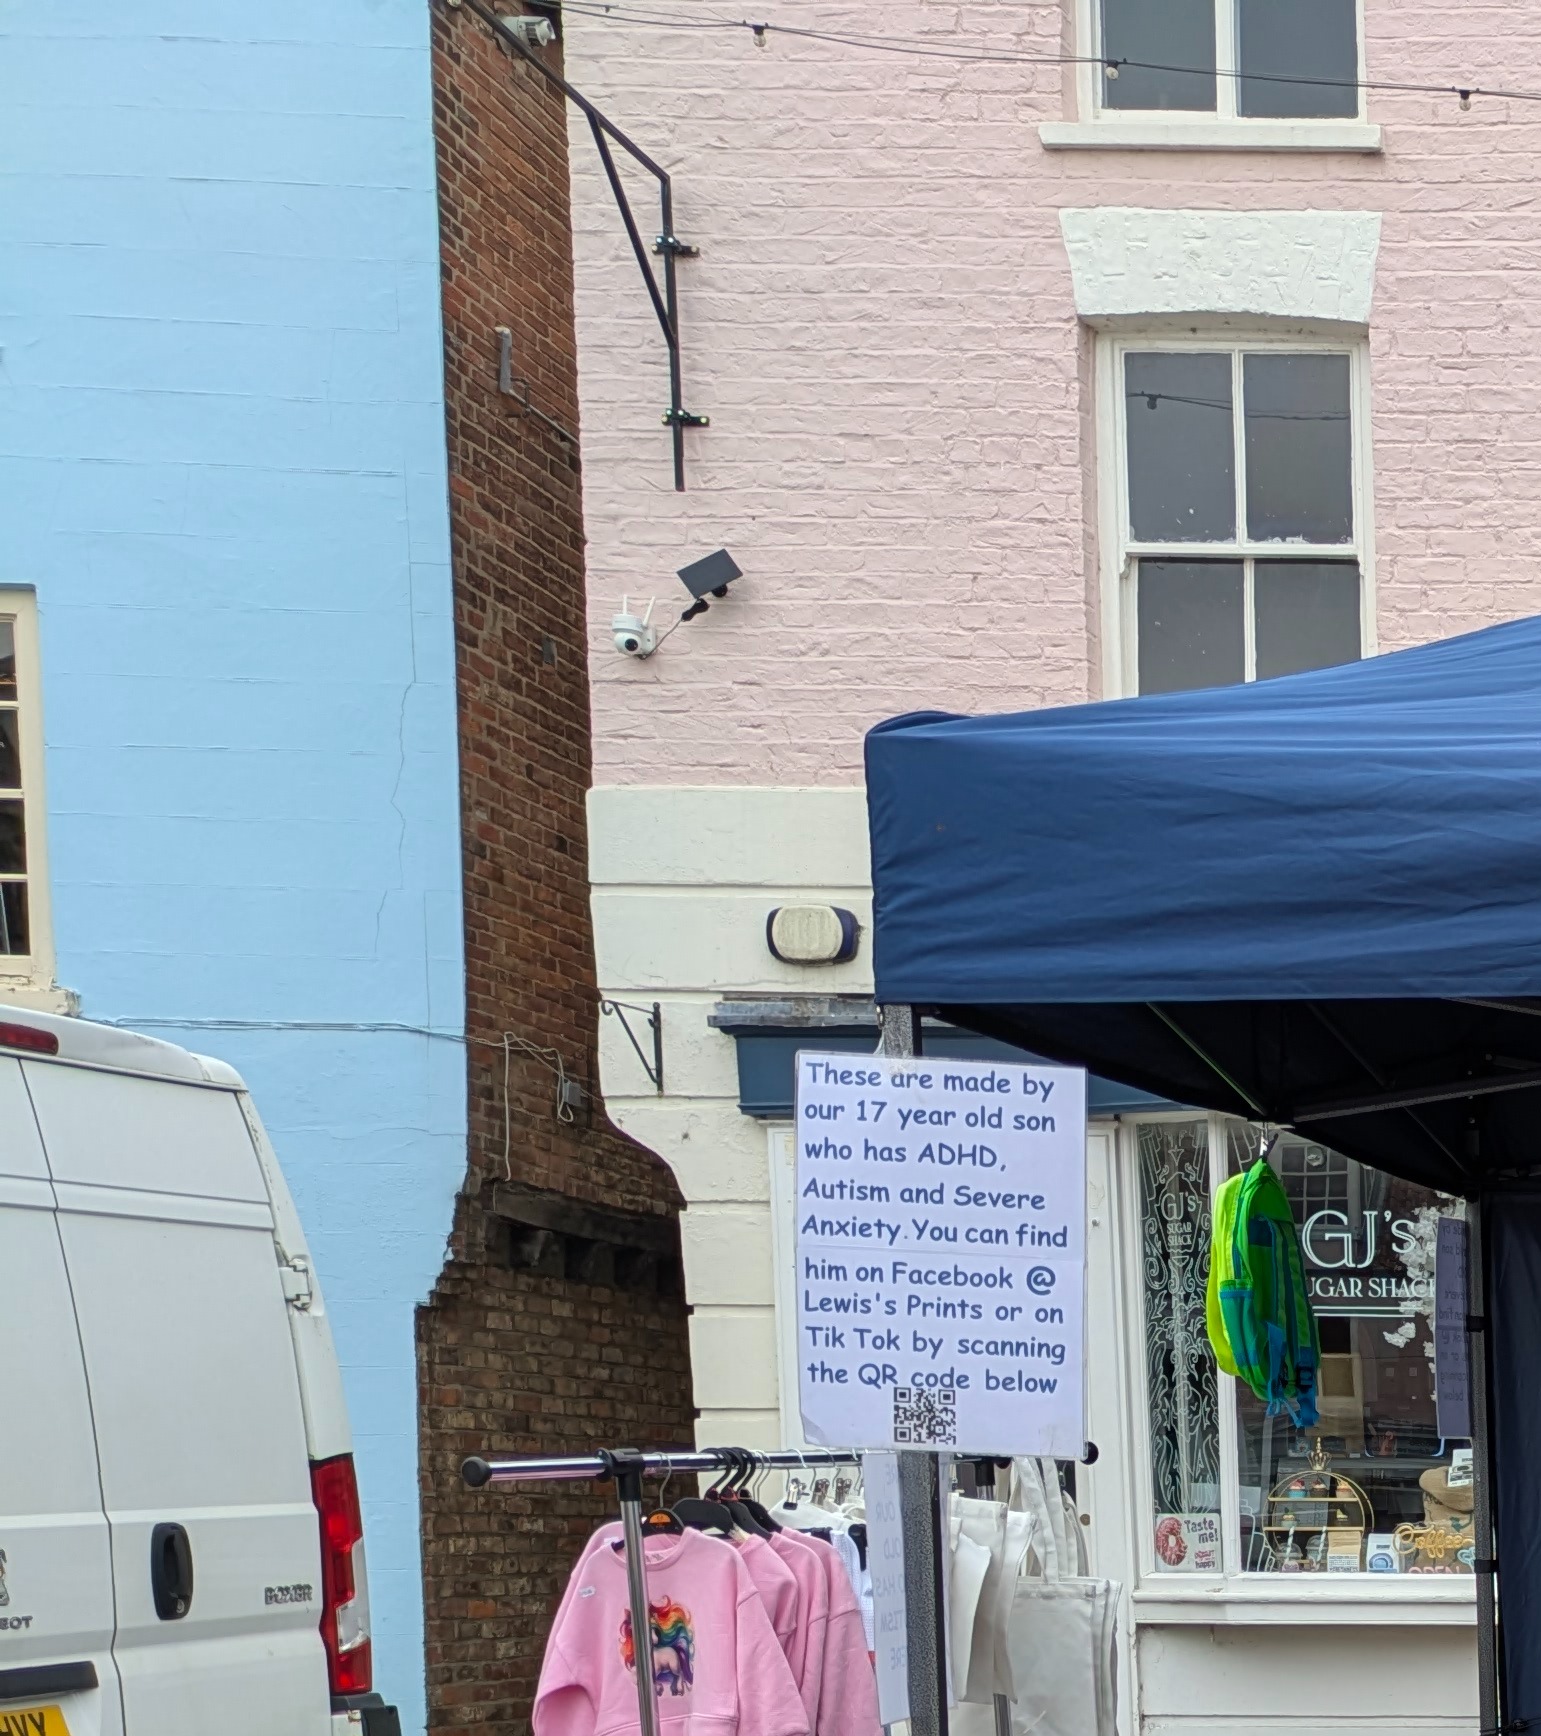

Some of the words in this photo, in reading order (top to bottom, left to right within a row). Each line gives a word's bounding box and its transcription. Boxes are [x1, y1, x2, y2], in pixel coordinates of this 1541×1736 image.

[806, 1062, 881, 1087] These
[891, 1072, 933, 1088] are
[944, 1071, 1010, 1094] made
[1024, 1073, 1054, 1102] by
[805, 1103, 844, 1120] our
[857, 1101, 886, 1122] 17
[898, 1108, 956, 1130] year
[965, 1106, 1002, 1128] old
[1013, 1113, 1055, 1132] son
[805, 1137, 852, 1159] who
[864, 1138, 906, 1162] has
[917, 1143, 1007, 1171] ADHD,
[803, 1177, 890, 1202] Autism
[900, 1183, 944, 1204] and
[953, 1185, 1046, 1209] Severe
[1161, 1193, 1196, 1220] GJ's
[802, 1215, 908, 1245] Anxiety.
[912, 1218, 957, 1242] You
[966, 1226, 1008, 1244] can
[1015, 1224, 1067, 1247] find
[1166, 1223, 1192, 1234] SUGAR
[1168, 1235, 1192, 1246] SHACK
[1302, 1209, 1417, 1269] GJ's
[805, 1257, 848, 1281] him
[856, 1266, 884, 1283] on
[892, 1262, 1013, 1288] Facebook
[1026, 1266, 1056, 1295] @
[804, 1290, 897, 1315] Lewis's
[907, 1295, 982, 1319] Prints
[995, 1305, 1022, 1321] or
[1035, 1306, 1063, 1324] on
[806, 1326, 845, 1348] Tik
[853, 1328, 900, 1350] Tok
[913, 1331, 943, 1359] by
[958, 1337, 1065, 1365] scanning
[808, 1361, 848, 1383] the
[858, 1364, 898, 1389] QR
[911, 1367, 970, 1389] code
[985, 1369, 1057, 1393] below
[1184, 1518, 1215, 1534] Taste
[1198, 1529, 1219, 1543] me!
[264, 1584, 312, 1605] BOXER
